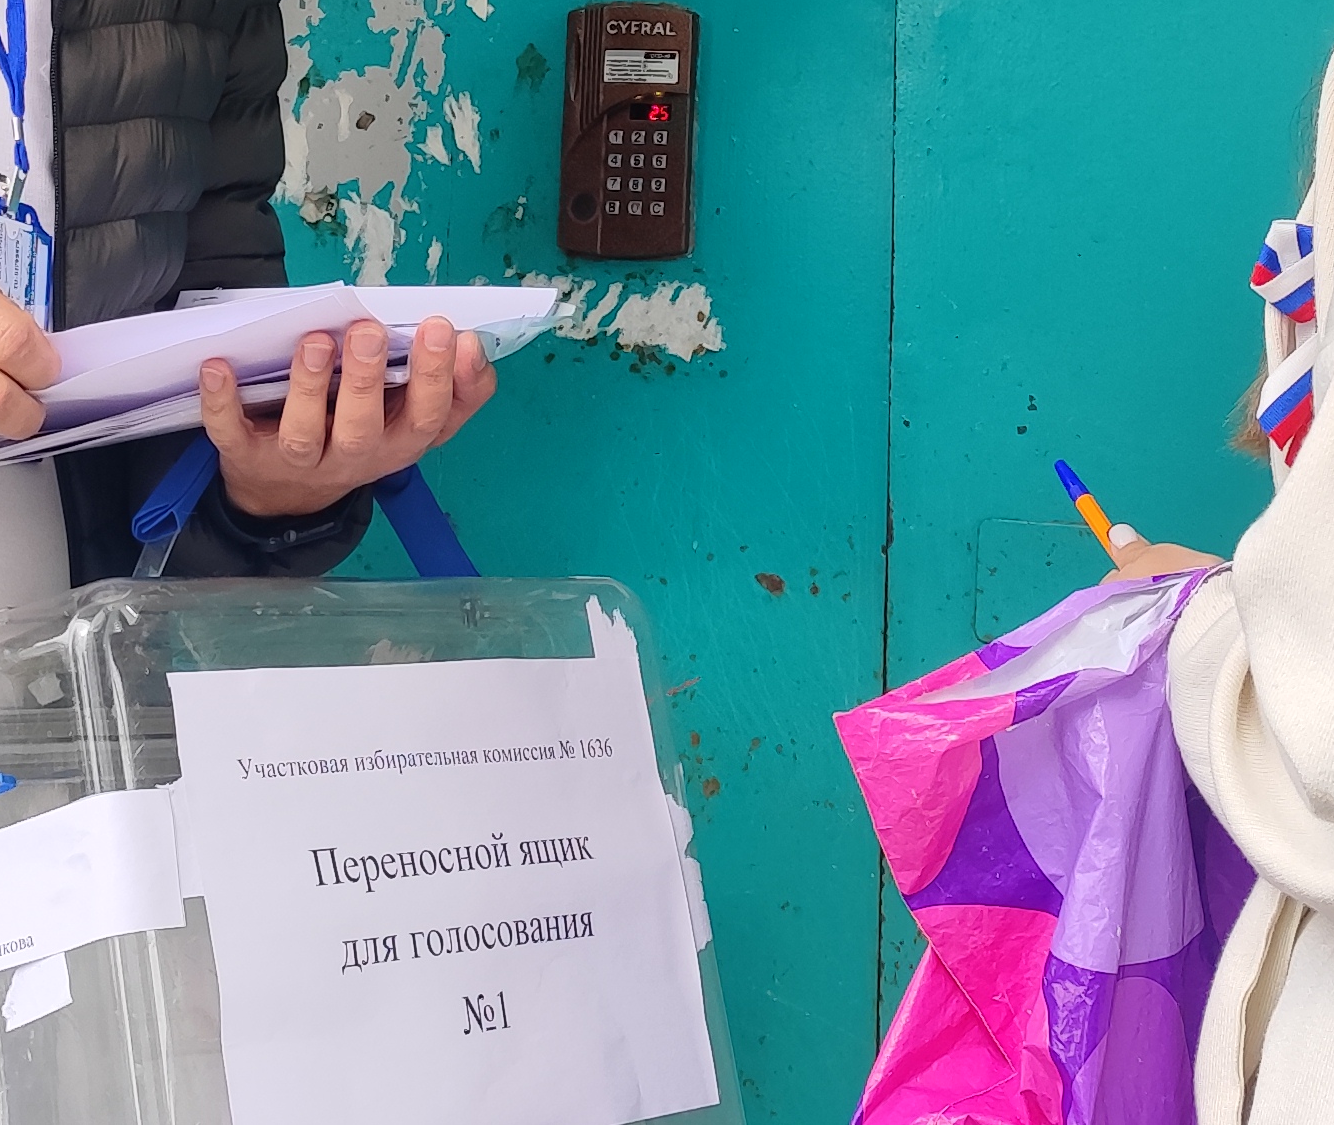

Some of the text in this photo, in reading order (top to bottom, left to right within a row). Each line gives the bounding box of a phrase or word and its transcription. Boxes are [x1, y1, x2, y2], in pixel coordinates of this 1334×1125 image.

[606, 19, 677, 36] CYFRAL
[648, 104, 669, 121] 25
[612, 131, 664, 144] 1 2 3
[610, 154, 663, 168] 4 5 6
[610, 178, 618, 190] 7
[654, 179, 662, 192] 9
[237, 736, 613, 780] Участковая избирательная комиссия № 1636
[308, 832, 596, 894] Переносной ящик
[341, 910, 596, 976] для голосования
[462, 990, 511, 1036] №1
